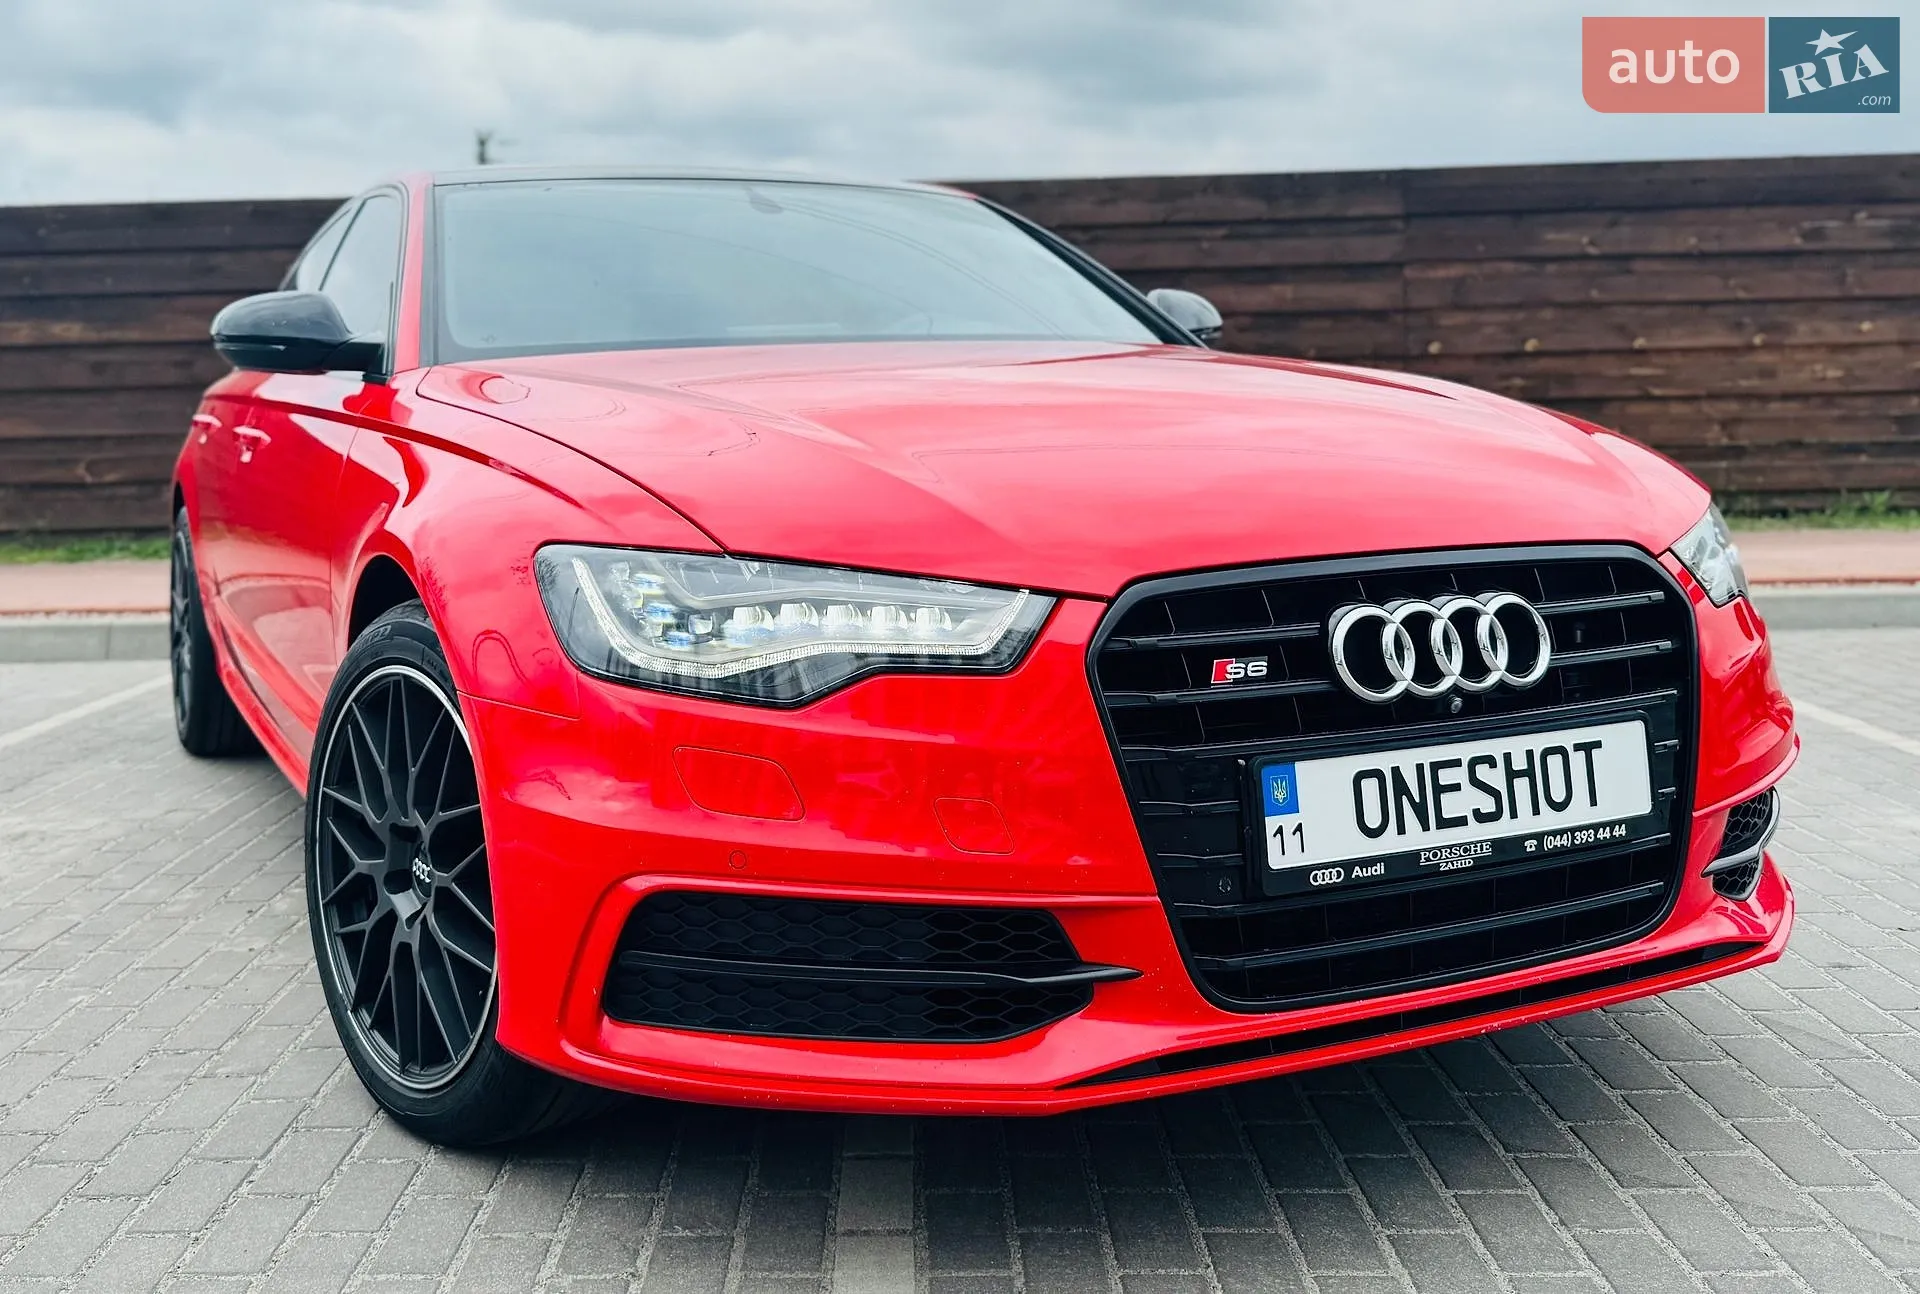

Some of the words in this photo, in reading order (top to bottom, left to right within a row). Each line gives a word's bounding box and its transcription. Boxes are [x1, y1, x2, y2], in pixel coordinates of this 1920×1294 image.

[1225, 661, 1268, 679] S6
[1352, 740, 1602, 839] ONESHOT
[1273, 822, 1304, 856] 11
[1543, 831, 1572, 851] (044)
[1573, 829, 1595, 844] 393
[1596, 827, 1611, 840] 44
[1612, 824, 1627, 838] 44
[1419, 842, 1492, 863] PORSCHE
[1351, 862, 1385, 878] Audi
[1439, 858, 1474, 871] ZAHID
